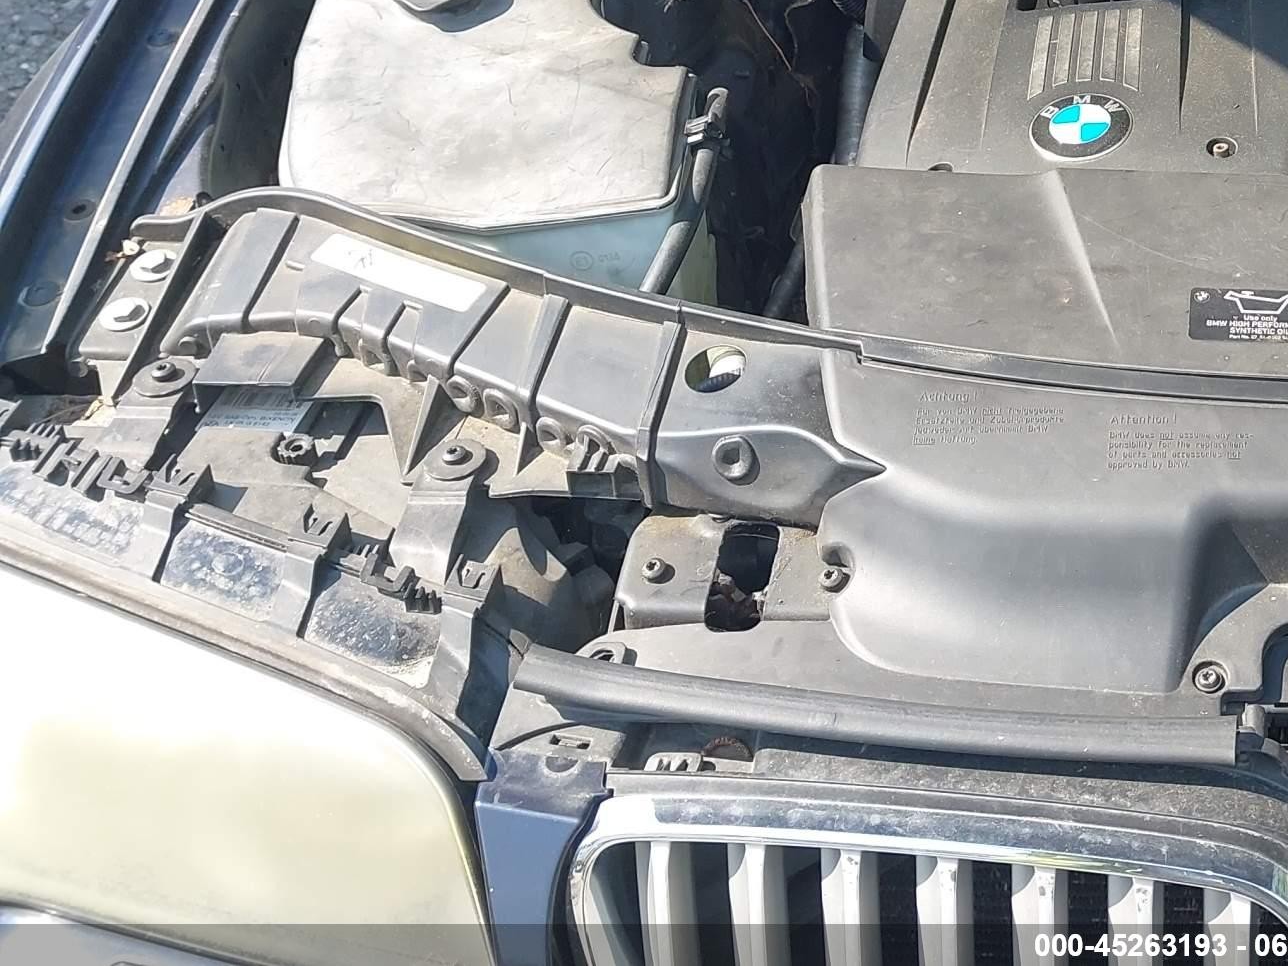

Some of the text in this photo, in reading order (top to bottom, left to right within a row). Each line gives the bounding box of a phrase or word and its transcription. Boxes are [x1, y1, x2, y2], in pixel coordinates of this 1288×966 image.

[1040, 94, 1124, 119] BMW
[1206, 319, 1228, 327] BMW
[1229, 320, 1250, 328] HIGH
[1260, 314, 1278, 323] only
[1229, 326, 1275, 335] SYNTHETIC
[919, 390, 970, 404] Achtung
[1109, 413, 1170, 426] Attention
[1109, 431, 1130, 440] BMW
[1135, 432, 1155, 440] does
[1159, 432, 1174, 441] not
[1108, 440, 1153, 451] ponsibility
[1158, 440, 1172, 449] for
[1176, 440, 1191, 450] the
[1107, 450, 1118, 459] of
[1150, 450, 1167, 459] and
[1107, 460, 1148, 471] approved
[1152, 461, 1163, 470] by
